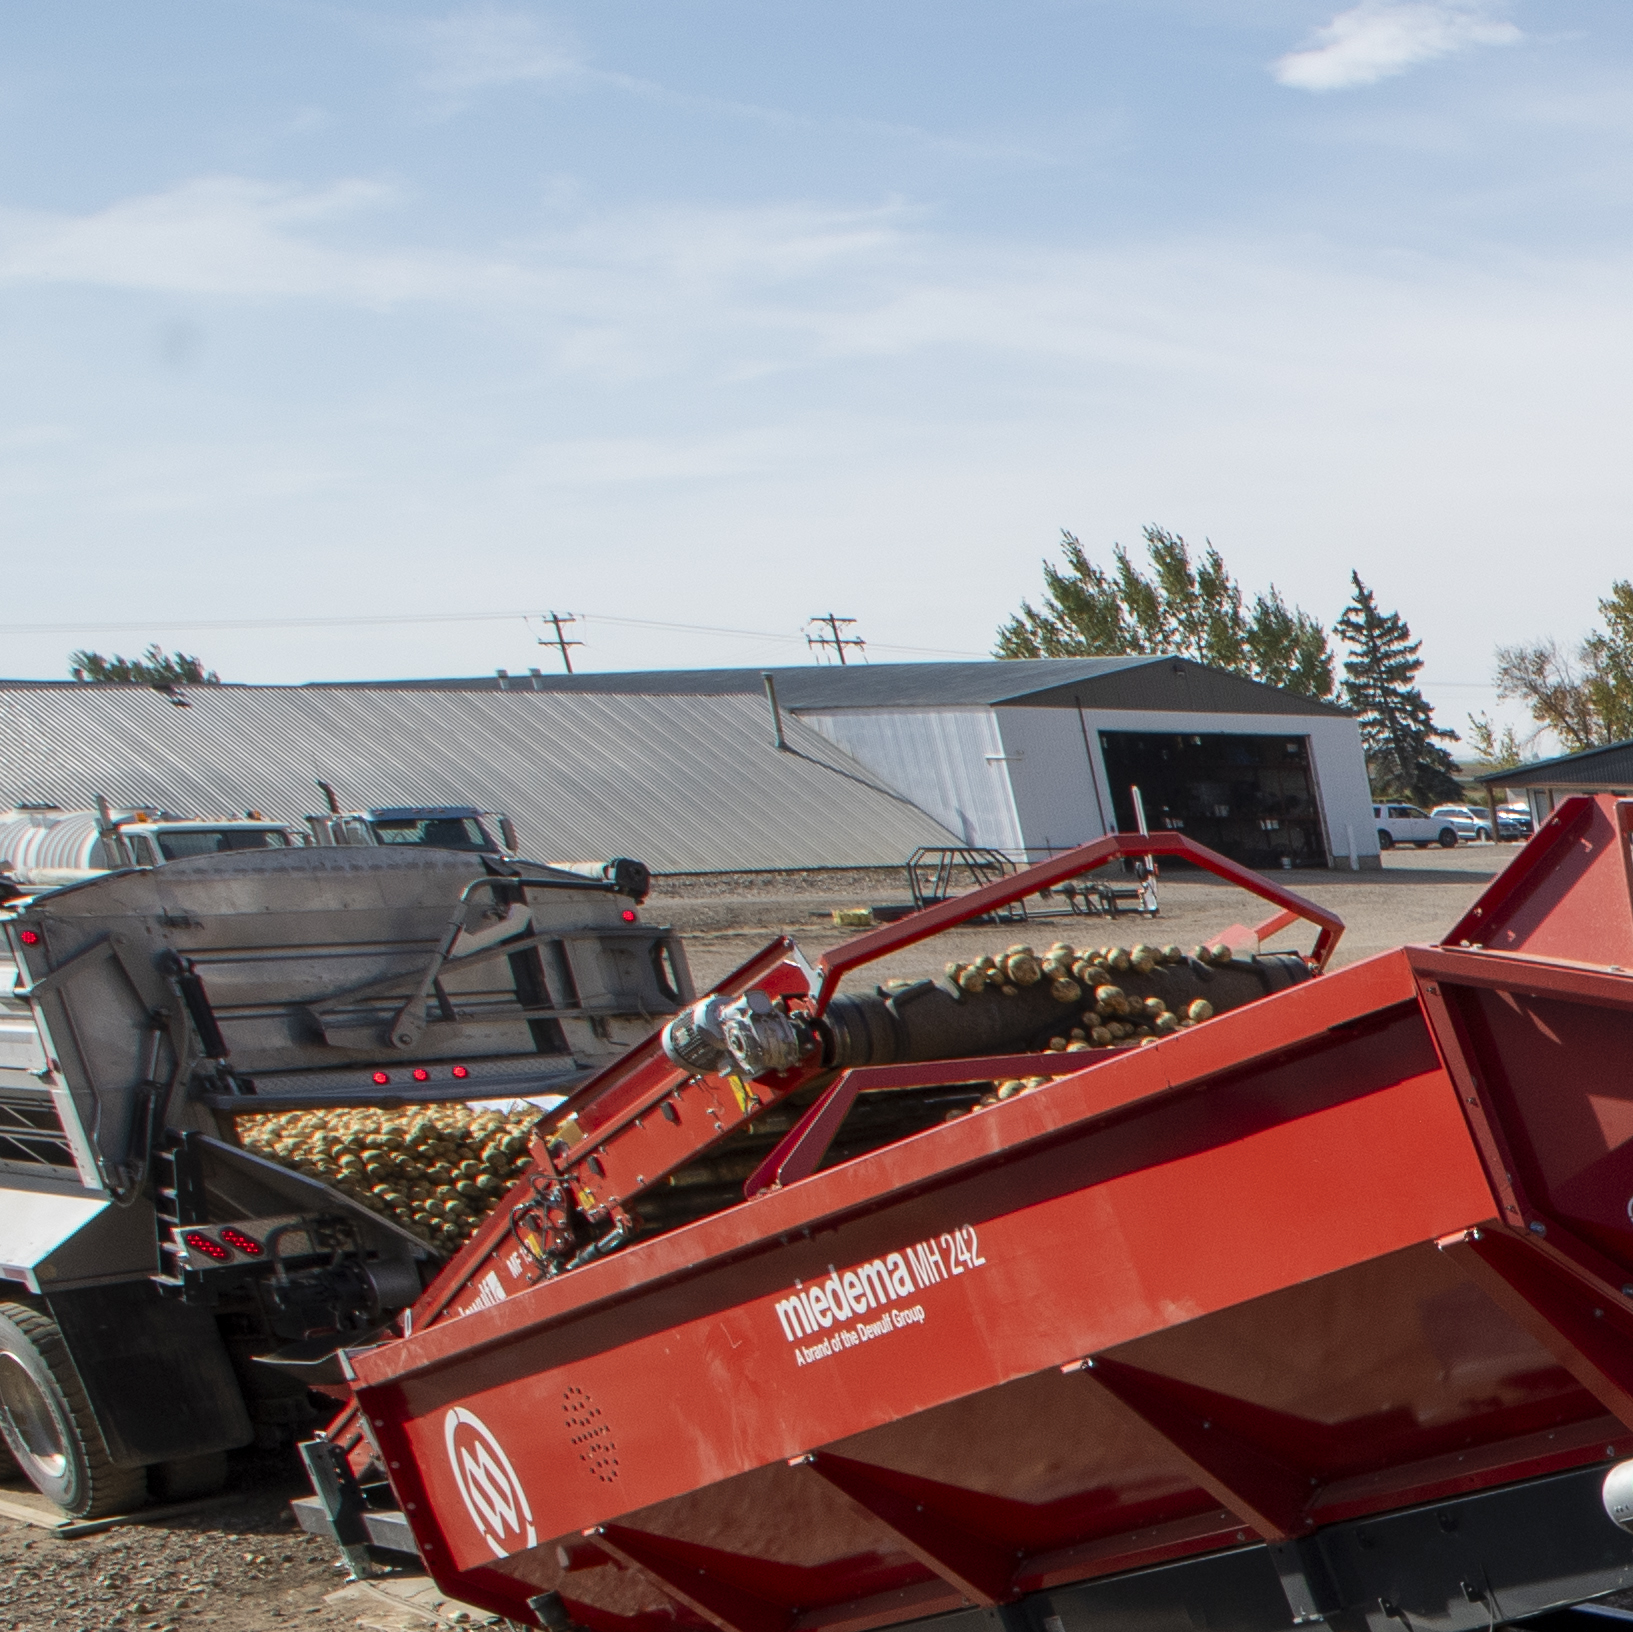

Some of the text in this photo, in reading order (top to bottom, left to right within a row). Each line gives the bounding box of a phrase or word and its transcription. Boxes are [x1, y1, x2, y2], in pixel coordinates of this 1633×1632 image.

[775, 1224, 986, 1342] miedema MH 242
[794, 1304, 926, 1367] A brand of the Dewulf Group
